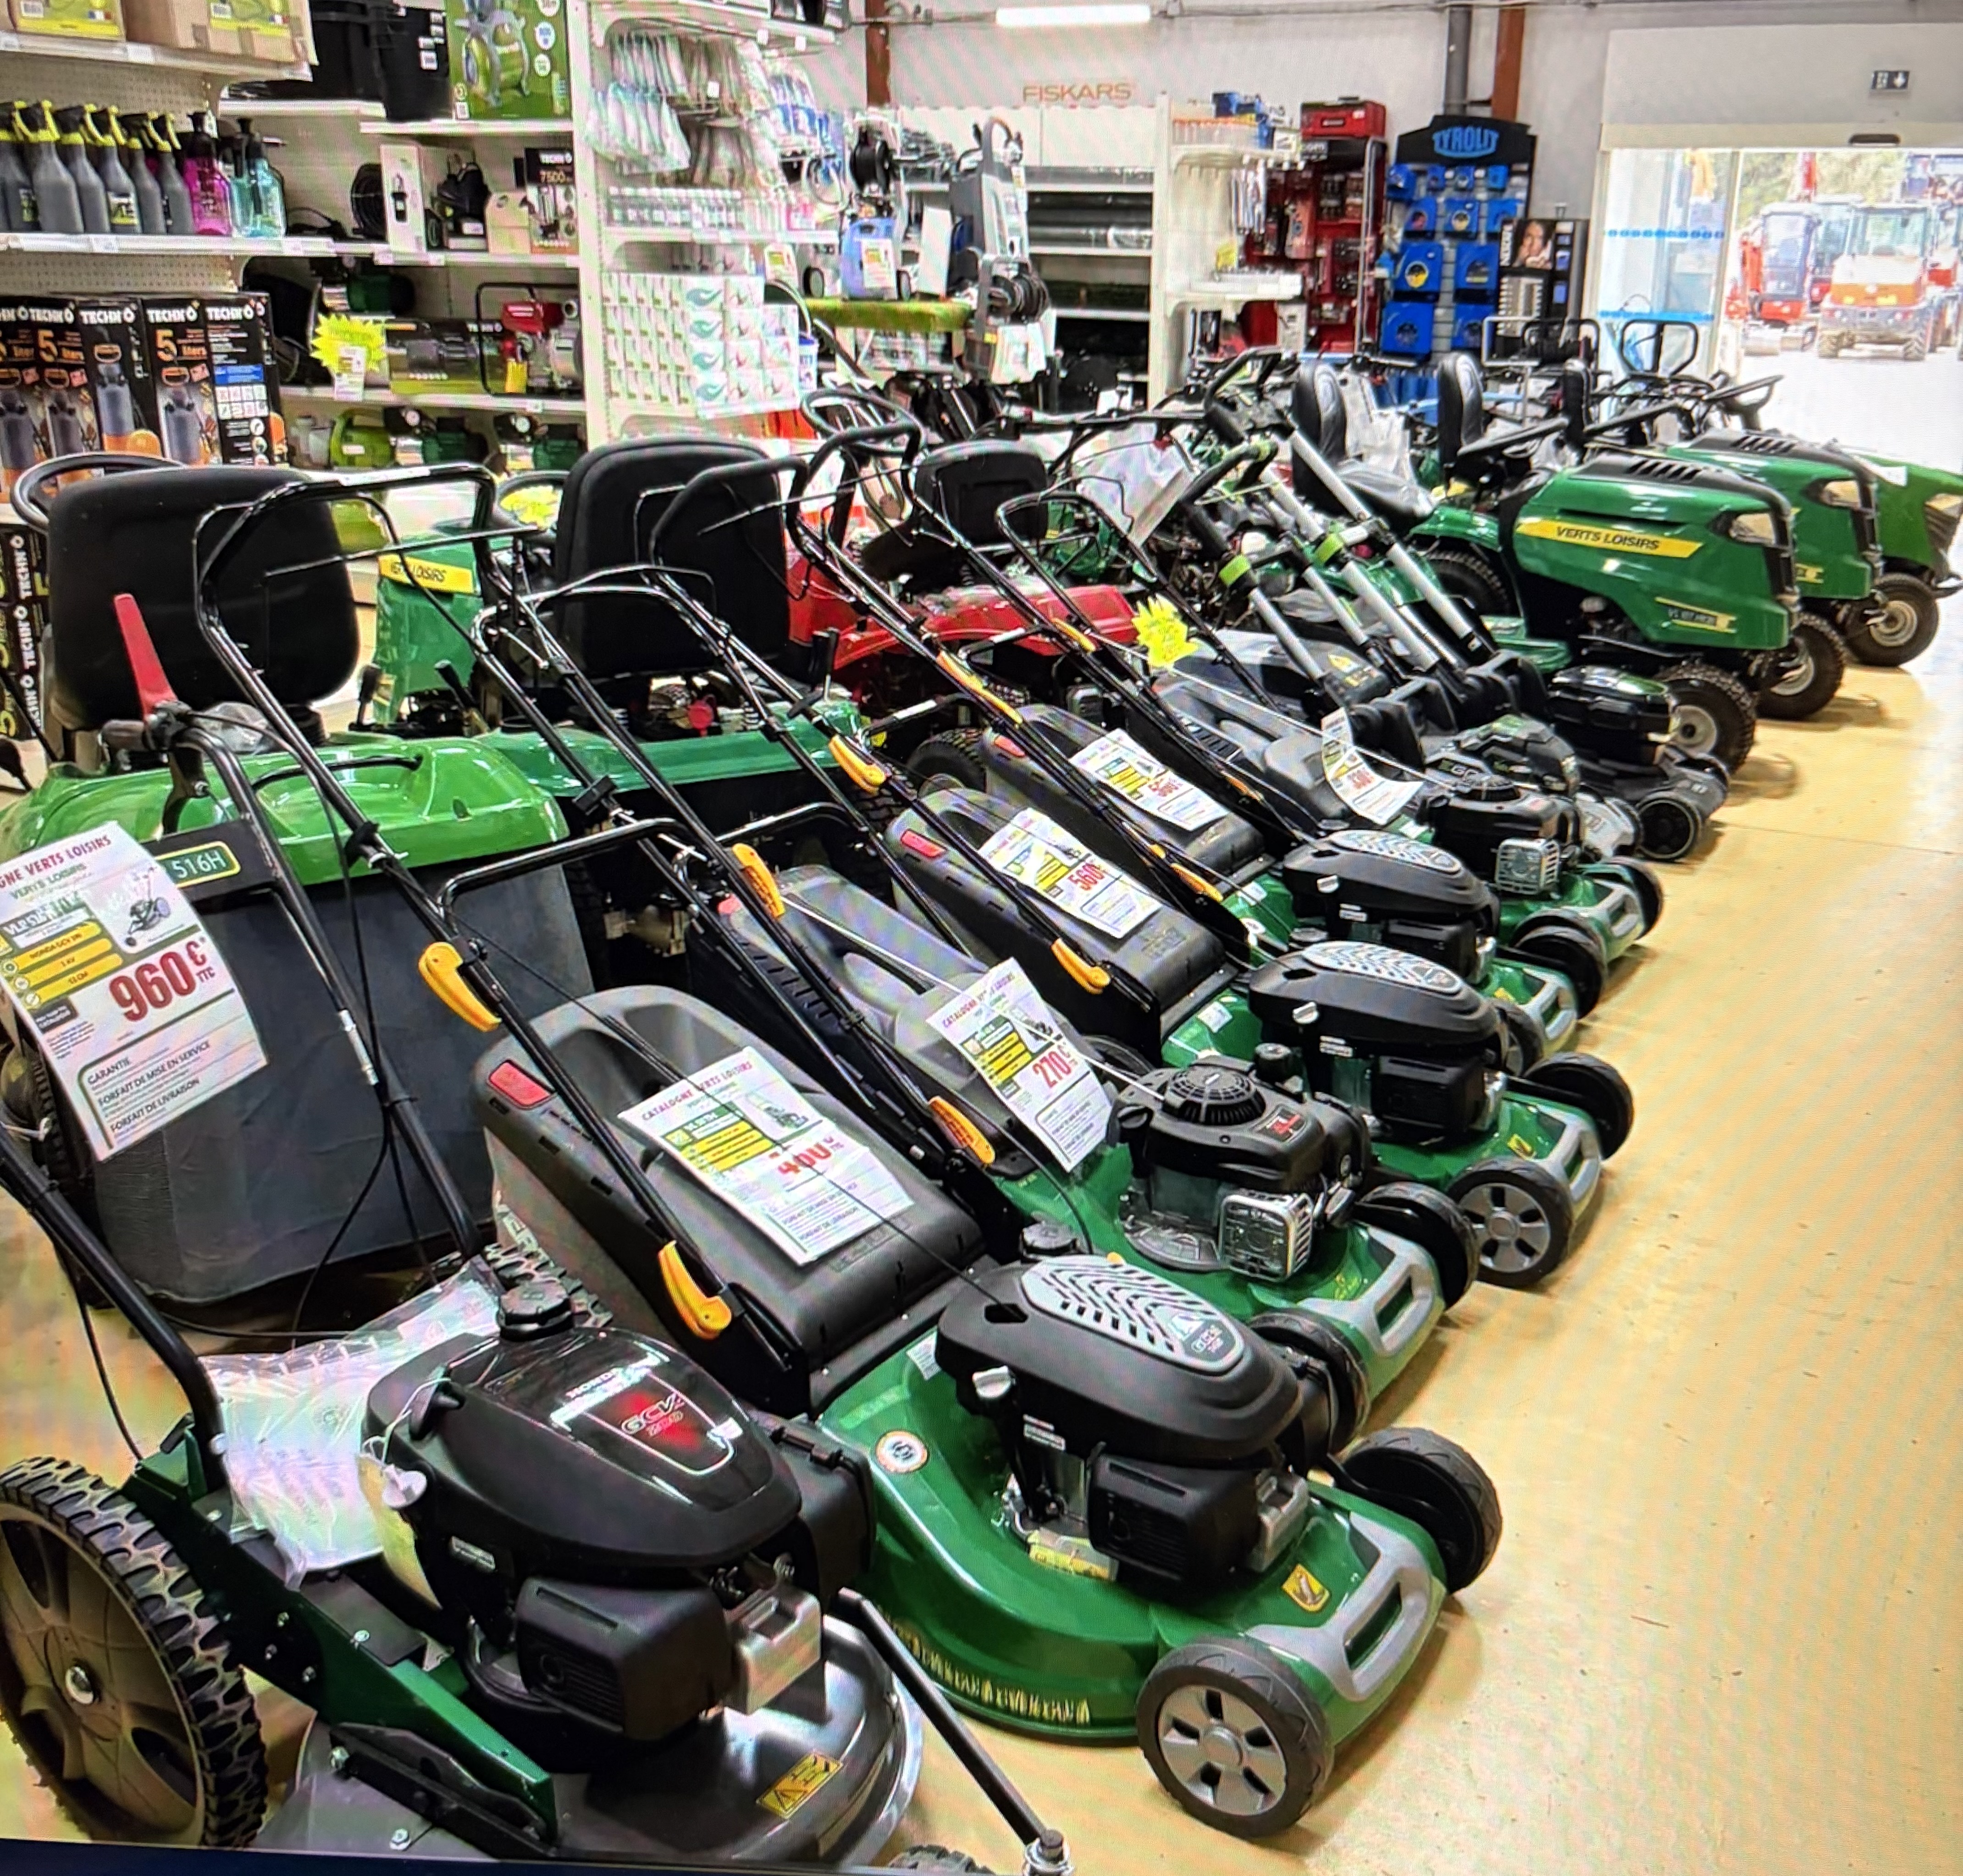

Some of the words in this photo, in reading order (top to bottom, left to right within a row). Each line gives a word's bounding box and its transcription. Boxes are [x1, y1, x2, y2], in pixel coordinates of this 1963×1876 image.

[1023, 83, 1131, 103] FISKARS
[1432, 125, 1500, 152] TYROLIT
[78, 306, 135, 325] TECHNO
[146, 304, 198, 323] TECHNO
[38, 329, 58, 363] 5
[155, 329, 177, 362] 5
[1556, 526, 1601, 541] VERTS
[1604, 533, 1660, 550] LOISIRS
[10, 535, 33, 600] TECHNO
[24, 852, 64, 876] VERTS
[66, 834, 111, 859] LOISIRS
[109, 951, 196, 1022] 960
[196, 966, 216, 983] TTC
[98, 1081, 133, 1107] FORFAIT
[134, 1075, 146, 1087] DE
[147, 1065, 166, 1080] MISE
[167, 1058, 179, 1069] EN
[179, 1040, 210, 1062] SERVICE
[696, 1075, 721, 1092] ERTS
[1032, 1051, 1072, 1089] 270
[111, 1108, 145, 1132] FORFAIT
[146, 1102, 158, 1113] DE
[158, 1079, 200, 1107] LIVRAISON
